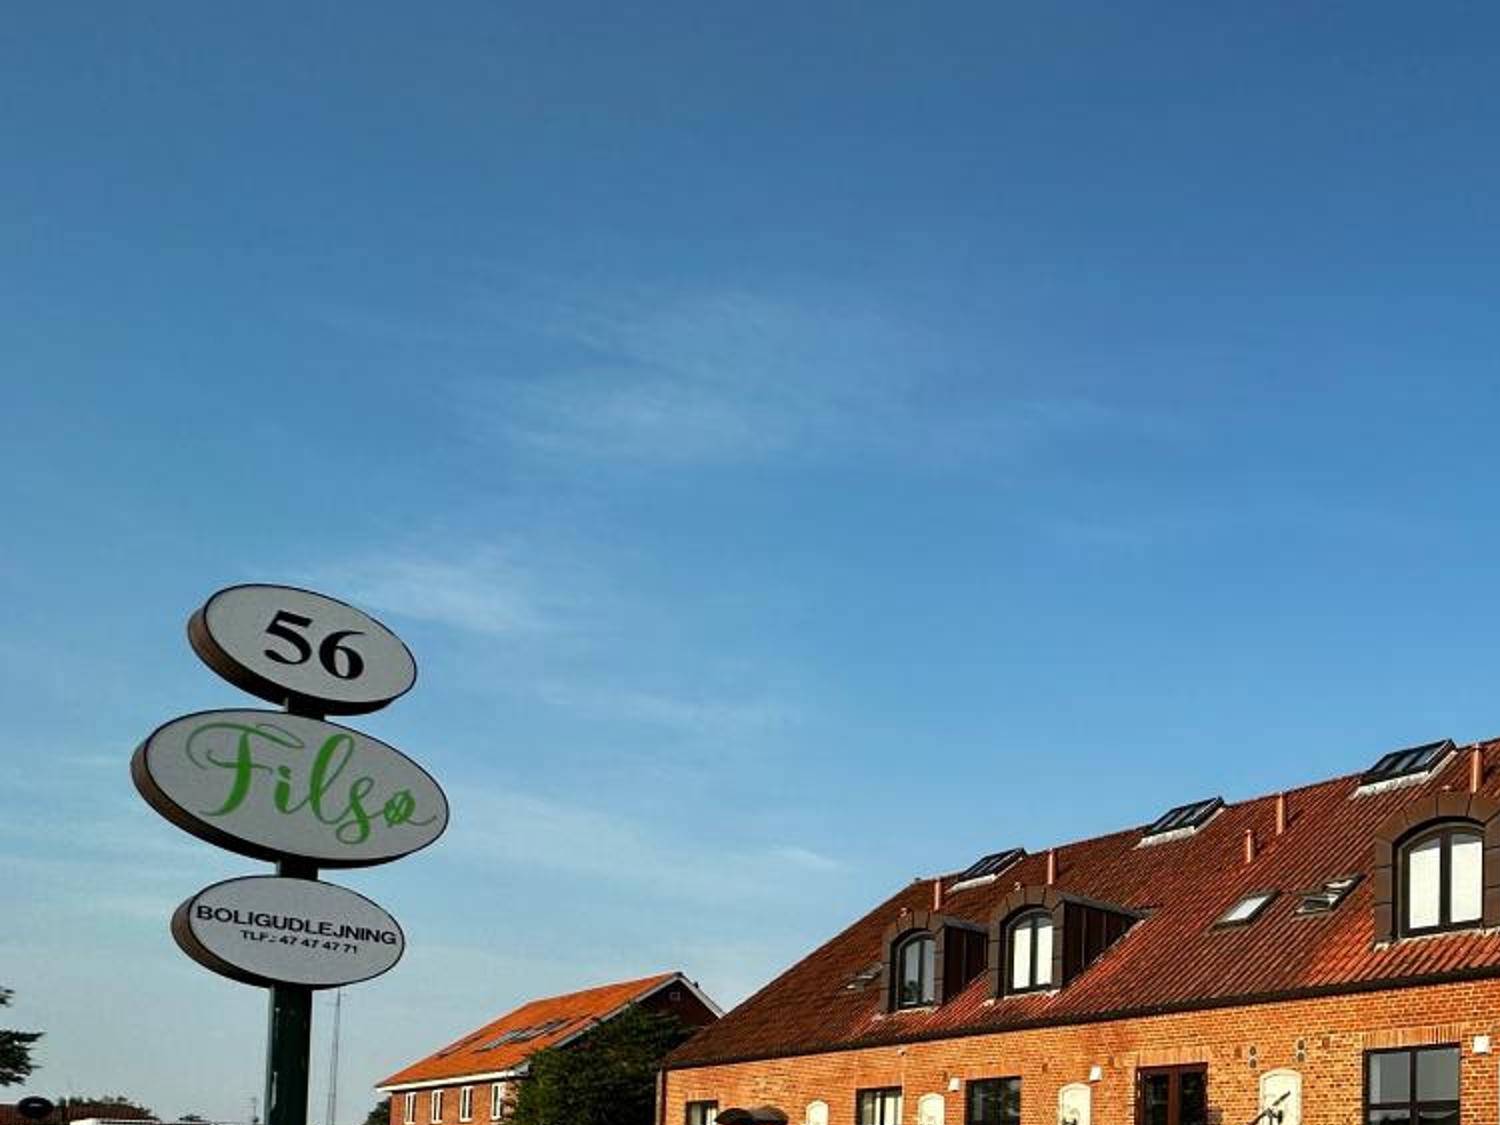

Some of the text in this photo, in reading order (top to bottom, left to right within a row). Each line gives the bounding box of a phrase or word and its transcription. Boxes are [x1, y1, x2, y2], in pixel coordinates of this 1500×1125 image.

[264, 610, 366, 680] 56
[186, 722, 437, 844] Filsø
[196, 905, 397, 945] BOLIGUDLEJNING
